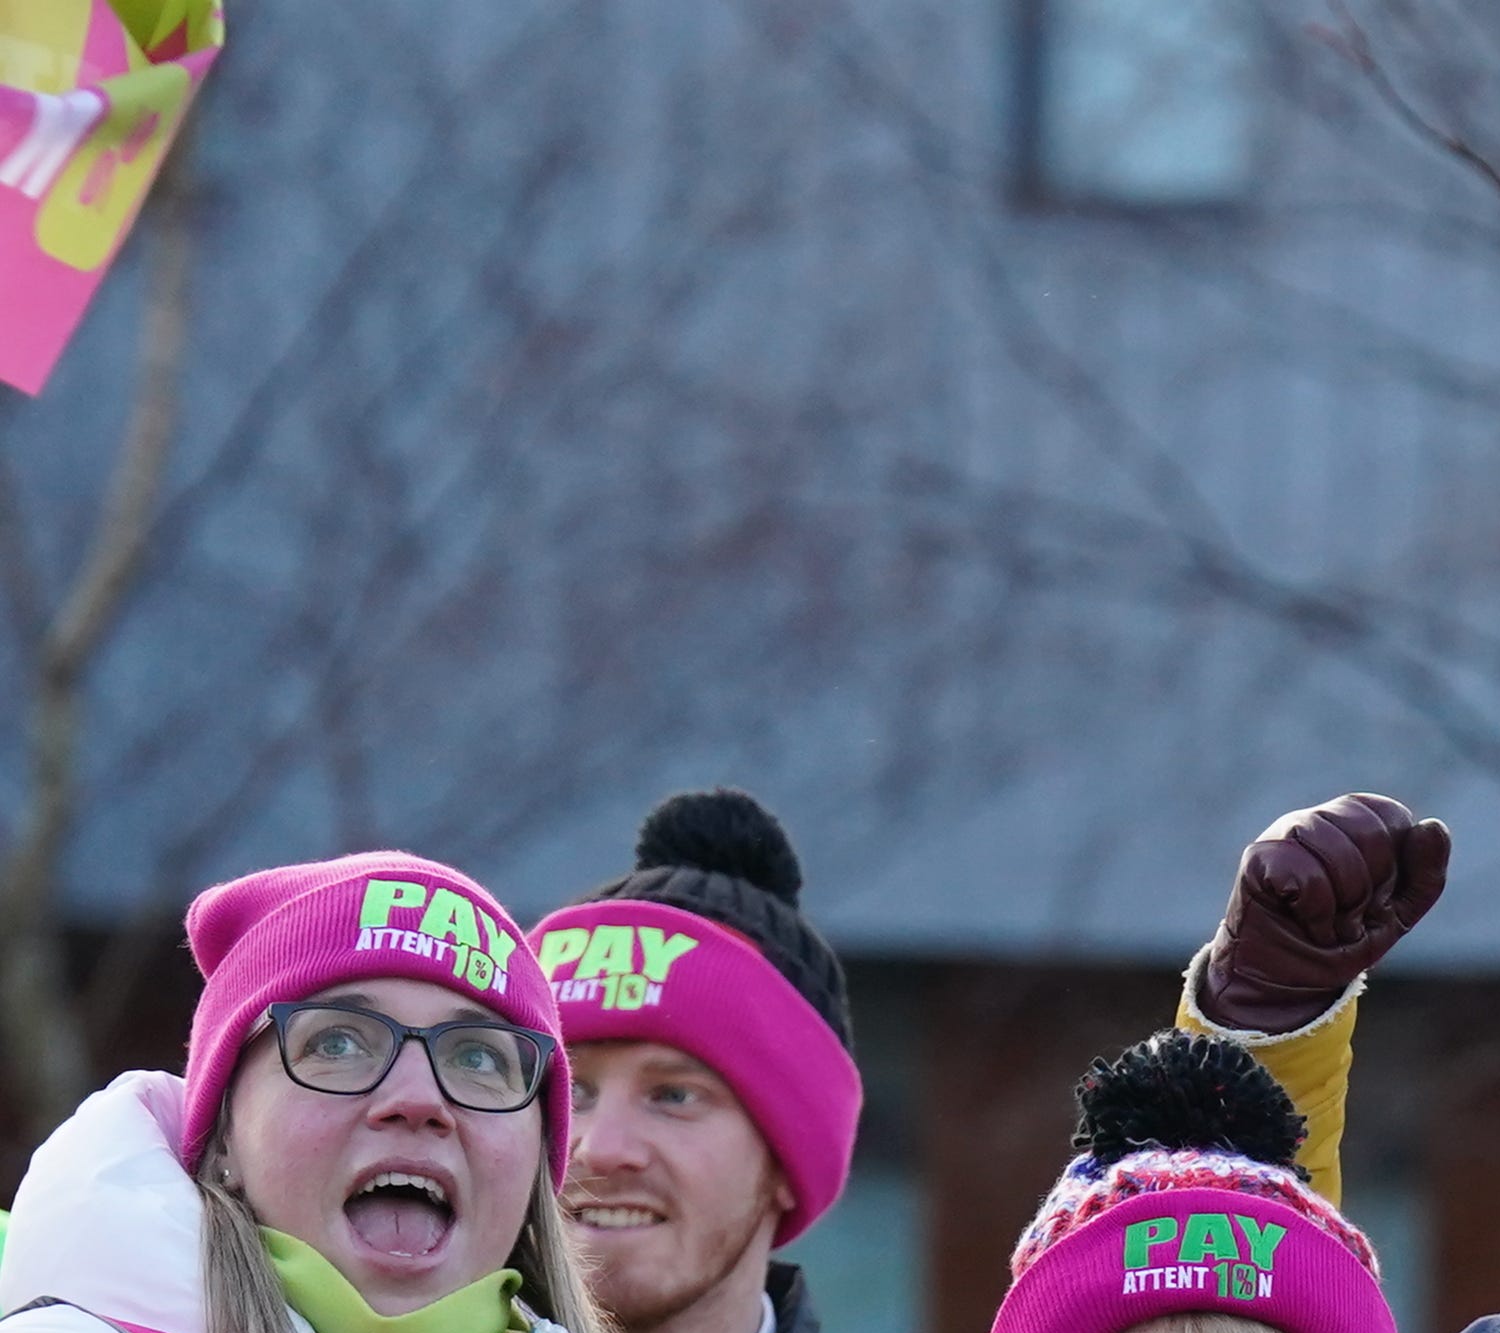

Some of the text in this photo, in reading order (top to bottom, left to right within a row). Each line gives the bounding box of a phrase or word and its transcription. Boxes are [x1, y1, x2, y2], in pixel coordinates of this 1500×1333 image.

[360, 879, 517, 967] PAY
[538, 925, 698, 984] PAY
[1123, 1213, 1288, 1271] PAY
